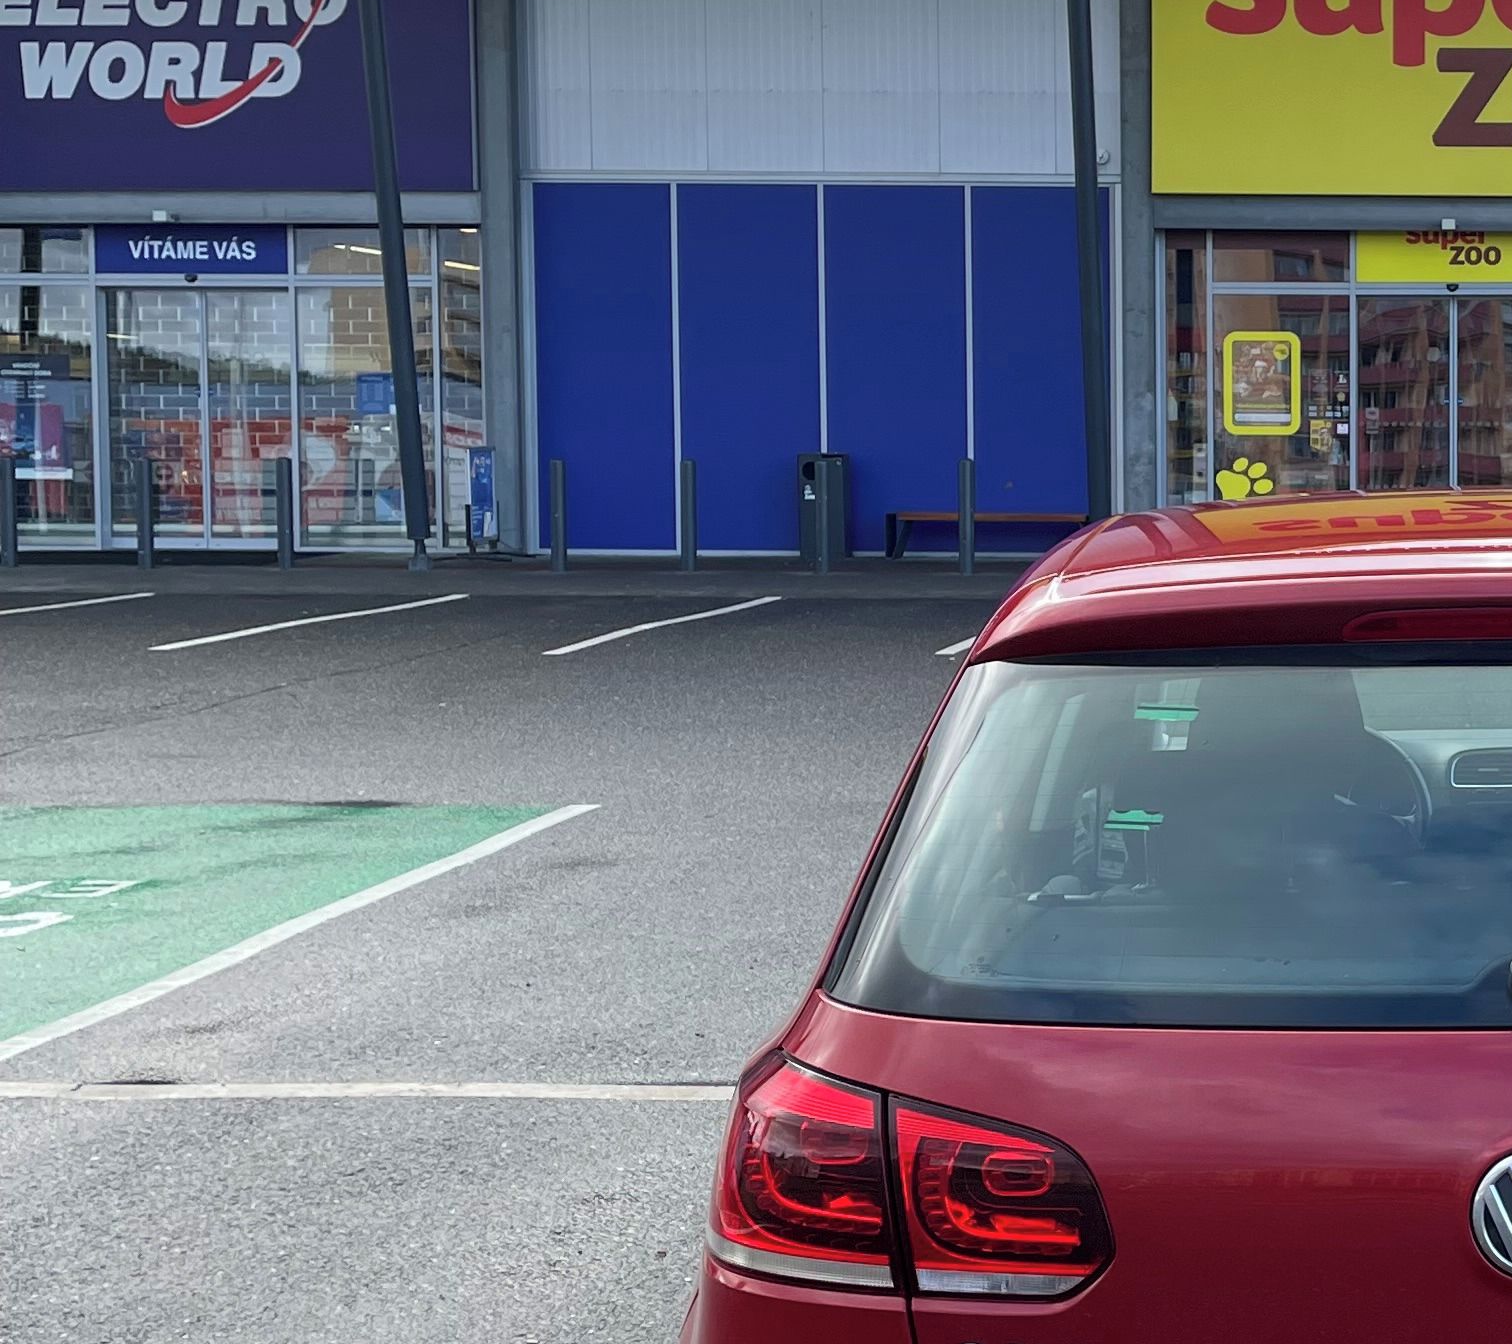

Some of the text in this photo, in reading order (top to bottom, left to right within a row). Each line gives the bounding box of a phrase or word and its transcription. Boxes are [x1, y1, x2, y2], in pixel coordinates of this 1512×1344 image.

[20, 41, 301, 99] WORLD
[128, 235, 257, 260] VÍTÁME VÁS
[1449, 246, 1502, 266] zoo
